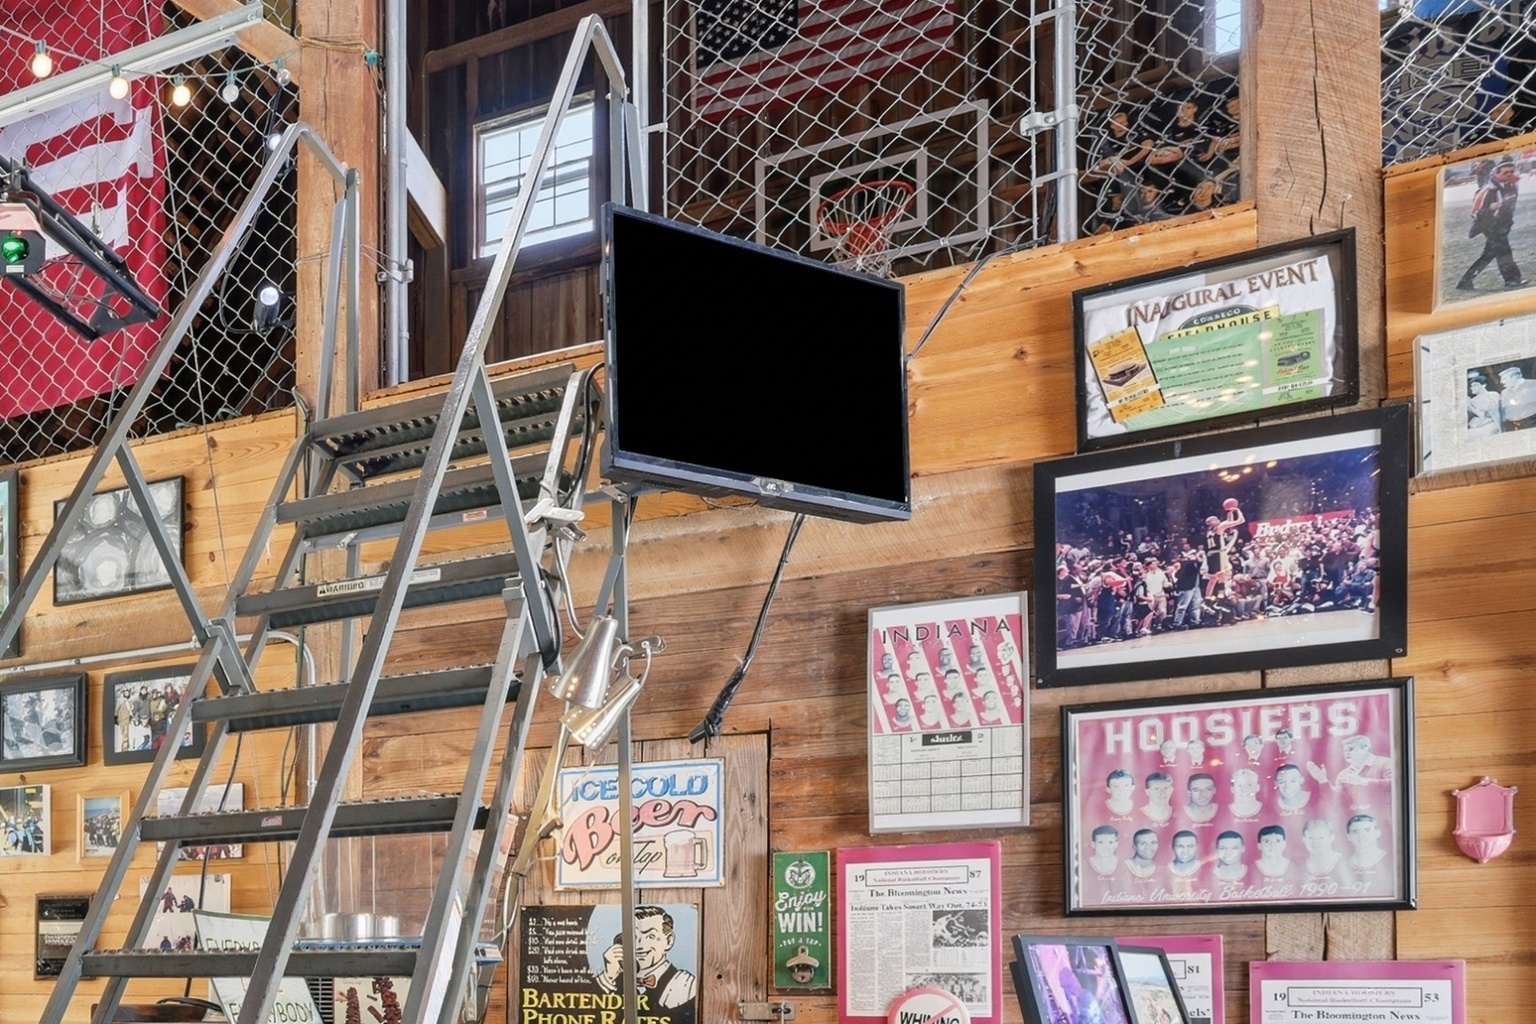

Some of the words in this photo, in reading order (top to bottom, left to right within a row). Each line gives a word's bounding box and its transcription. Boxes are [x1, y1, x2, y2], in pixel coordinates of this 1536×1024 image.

[1128, 282, 1241, 326] INAUGURAL
[1248, 260, 1318, 295] EVENT
[1193, 307, 1241, 325] CONSECO
[882, 618, 1011, 645] INDIANA
[1105, 702, 1360, 756] HOOSIERS
[572, 778, 620, 802] ICE
[631, 774, 709, 800] COLD
[562, 799, 717, 871] Beer
[632, 840, 663, 875] Tap
[854, 874, 865, 883] 19
[969, 870, 982, 879] 87
[775, 890, 827, 912] Enjoy
[869, 889, 885, 898] The
[887, 888, 941, 899] Bloomington
[943, 886, 968, 896] News
[1101, 888, 1145, 904] Indiana
[1150, 888, 1212, 905] University
[1218, 883, 1294, 900] Basketball
[881, 903, 902, 911] Takes
[777, 911, 824, 934] WIN!
[522, 988, 651, 1011] BARTENDR
[1273, 992, 1287, 1002] 19
[1424, 993, 1440, 1002] 53
[1291, 1010, 1314, 1020] The
[1316, 1010, 1386, 1021] Bloomington
[1389, 1011, 1421, 1021] News
